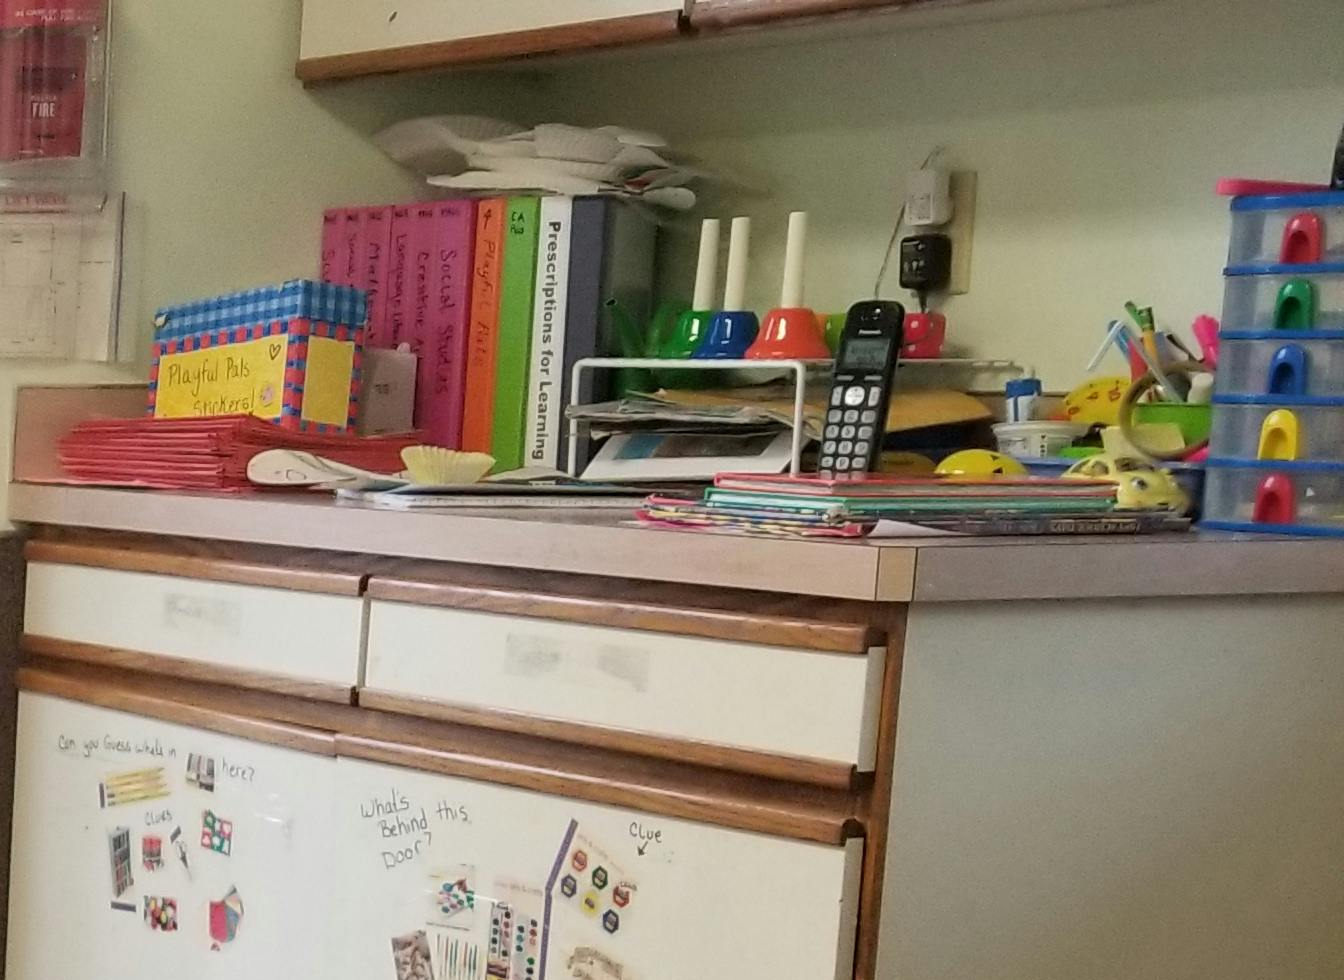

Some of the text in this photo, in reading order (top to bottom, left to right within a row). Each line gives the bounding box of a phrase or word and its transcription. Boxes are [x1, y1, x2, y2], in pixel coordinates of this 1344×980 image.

[32, 102, 56, 118] FIRE
[439, 249, 457, 309] Social
[531, 221, 562, 460] Prescriptions for Learning
[168, 356, 250, 397] Playful Pals
[58, 735, 76, 750] Can
[84, 740, 99, 757] you
[169, 748, 177, 758] in
[222, 757, 256, 782] here?
[378, 808, 428, 838] Behind
[629, 821, 662, 843] Clue
